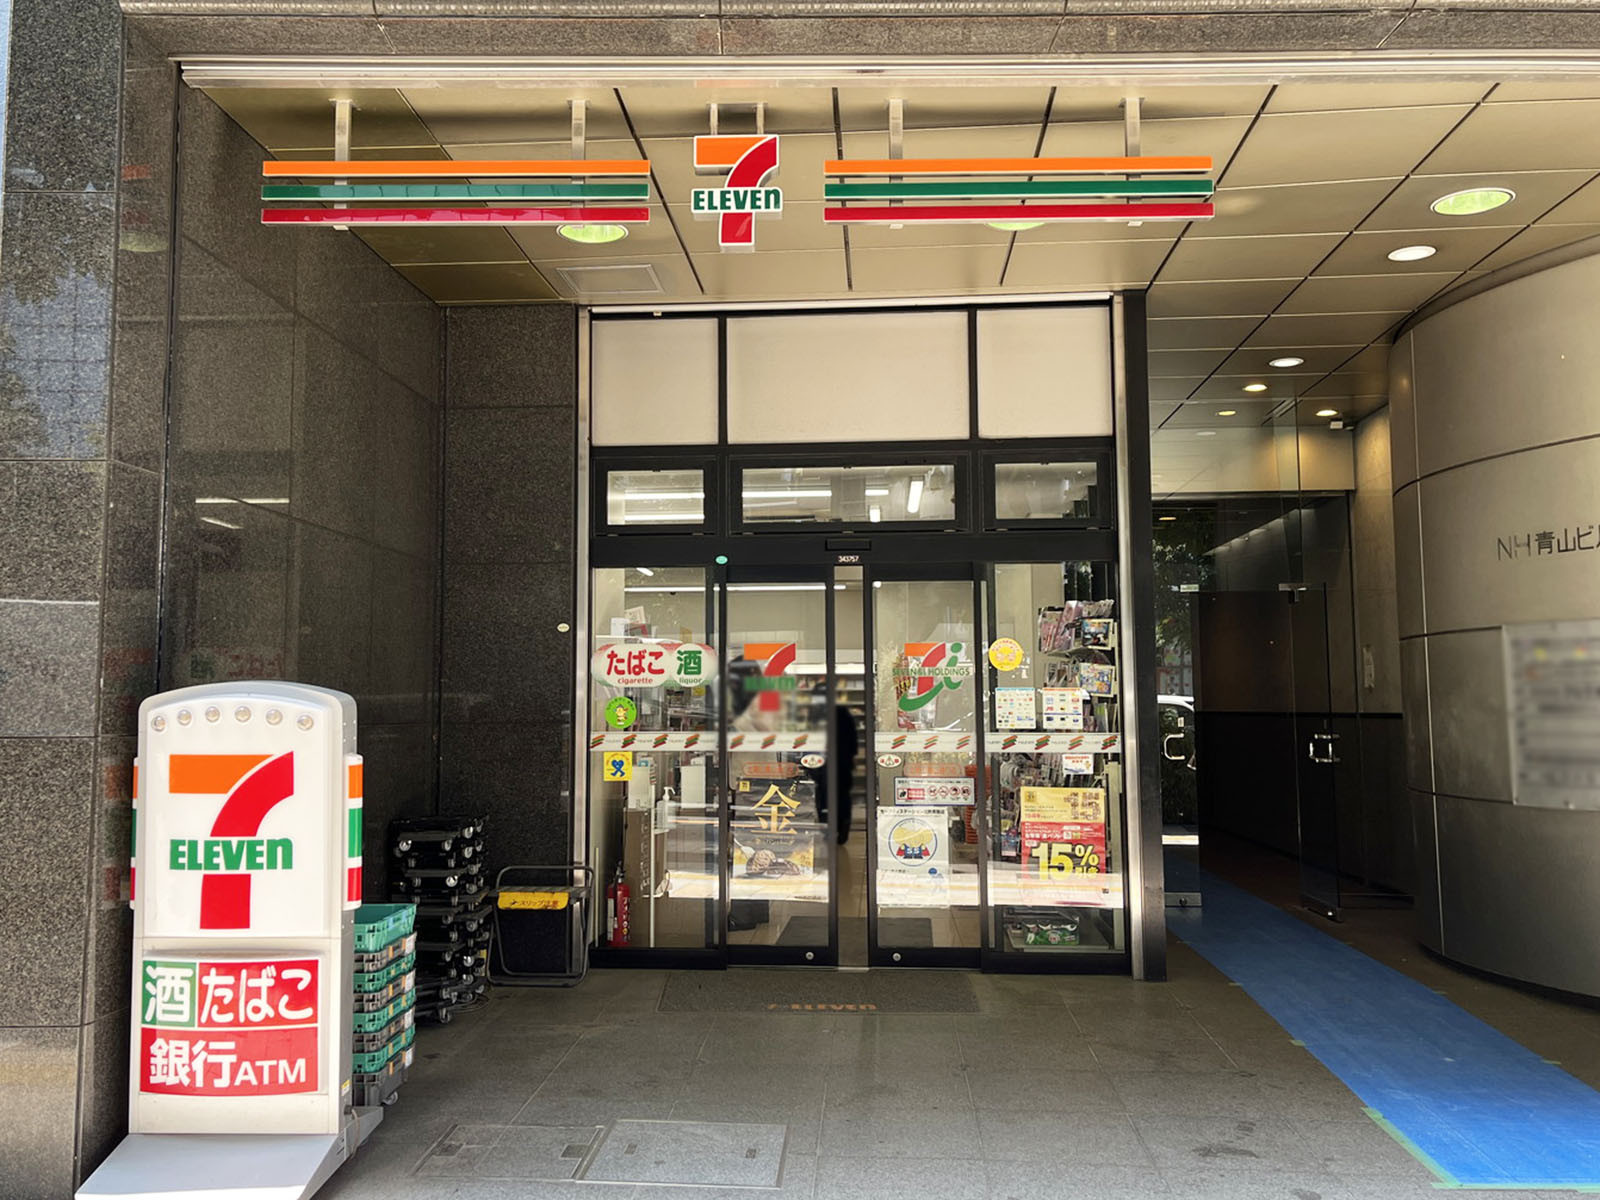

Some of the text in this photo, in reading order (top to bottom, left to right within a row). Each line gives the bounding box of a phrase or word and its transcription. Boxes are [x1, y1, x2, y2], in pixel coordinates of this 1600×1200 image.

[695, 136, 778, 245] 7
[606, 649, 703, 676] たばこ 酒
[617, 677, 703, 685] cigarette liquor
[928, 667, 970, 676] HOLDINGS
[750, 783, 801, 834] 金
[169, 751, 294, 930] 7
[144, 965, 314, 1025] 酒 たばこ
